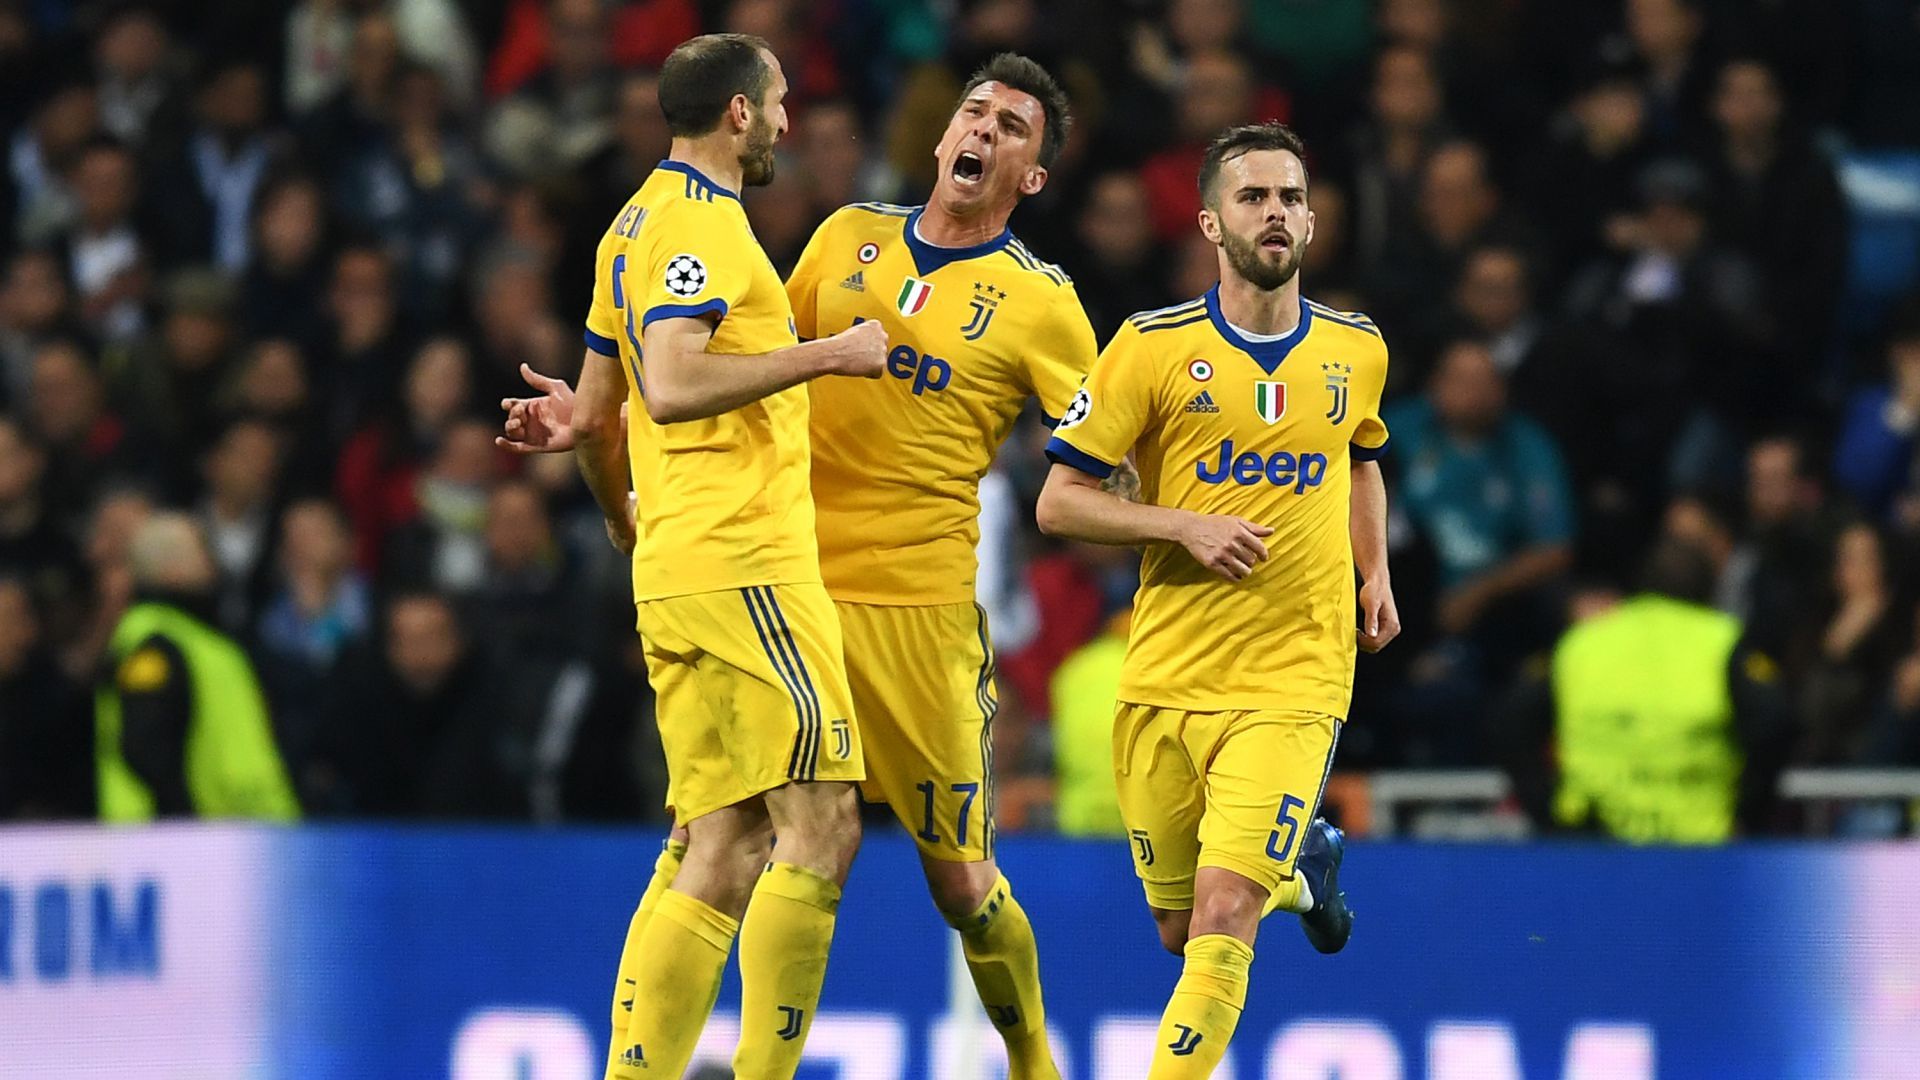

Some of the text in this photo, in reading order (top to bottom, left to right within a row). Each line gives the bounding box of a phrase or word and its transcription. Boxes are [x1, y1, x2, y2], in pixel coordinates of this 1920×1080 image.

[1184, 404, 1220, 413] adidas
[1195, 439, 1327, 495] Jeep
[916, 780, 979, 846] 17
[1265, 793, 1305, 862] 5
